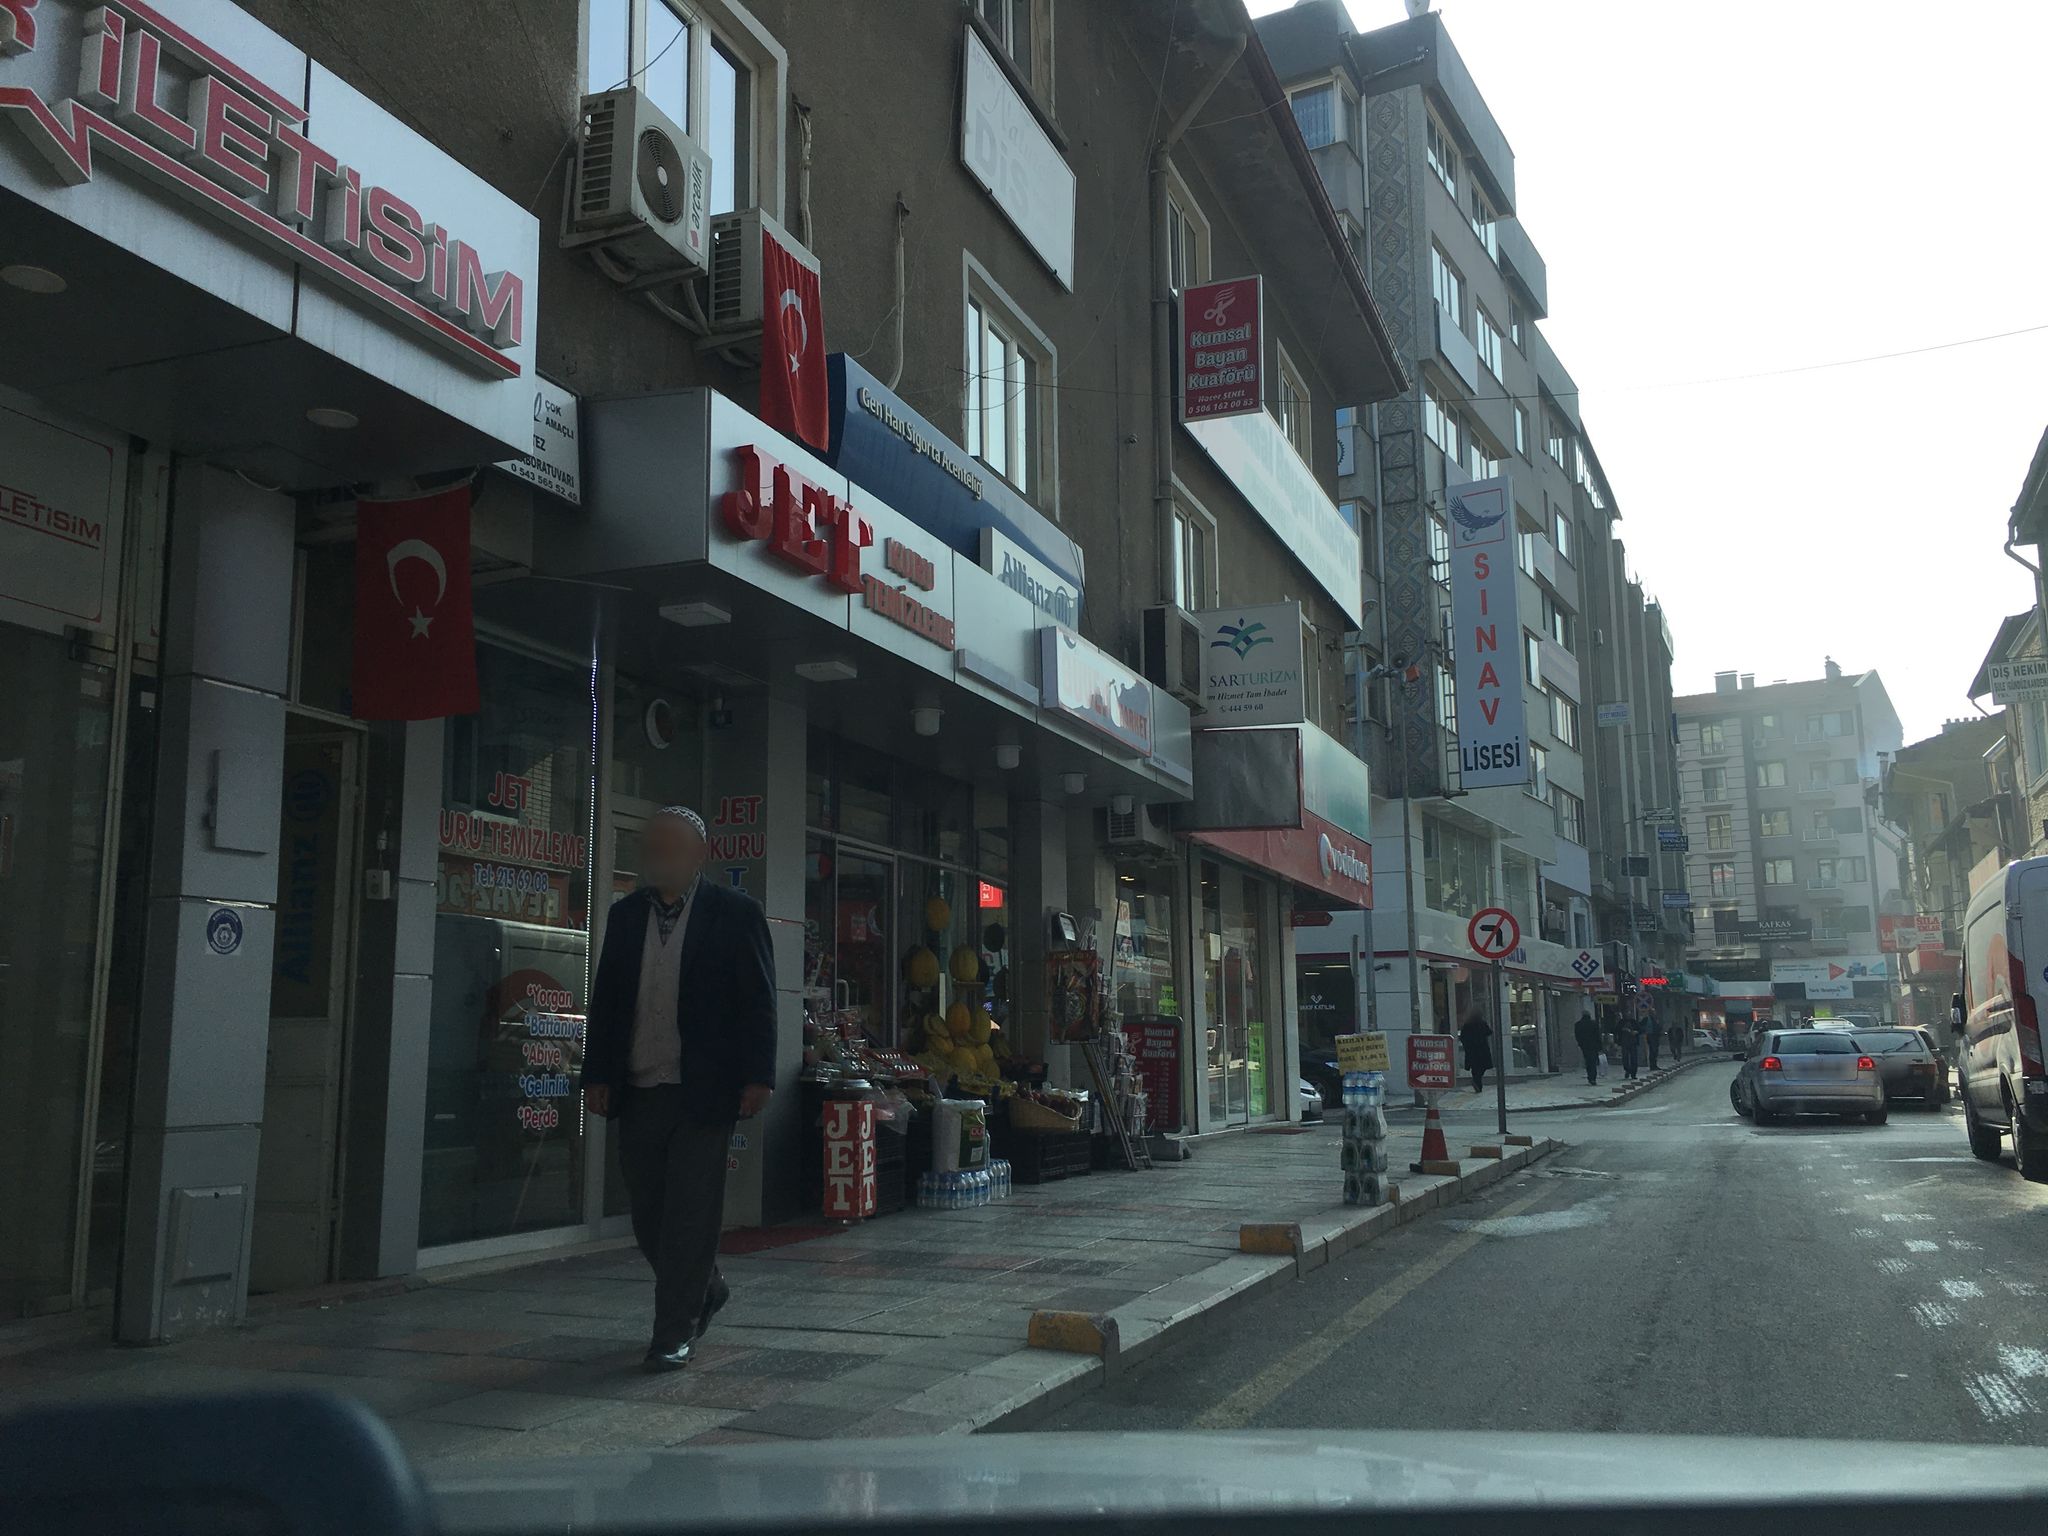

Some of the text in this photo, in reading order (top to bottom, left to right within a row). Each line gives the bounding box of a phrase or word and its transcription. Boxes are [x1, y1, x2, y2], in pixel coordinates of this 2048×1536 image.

[690, 160, 704, 230] arçelik
[1190, 323, 1252, 348] Kumsal
[1195, 347, 1248, 369] Bayan
[1187, 364, 1256, 390] Kuaförü
[545, 400, 562, 417] ÇOK
[545, 417, 575, 440] AMAÇLI
[860, 386, 885, 420] Gen
[883, 405, 907, 436] Han
[905, 423, 941, 465] Sigorta
[519, 468, 536, 481] 543
[520, 454, 575, 489] ABORATUVARI
[0, 491, 101, 543] LETİSİM
[718, 444, 873, 594] JET
[1001, 550, 1052, 609] Allianz
[1473, 552, 1501, 727] SINAV
[2013, 661, 2048, 677] HEKİM
[1246, 689, 1262, 698] Tam
[1462, 736, 1521, 772] LİSESİ
[489, 770, 532, 811] JET
[713, 795, 764, 827] JET
[438, 808, 587, 870] URU TEMİZLEME
[709, 832, 766, 861] KURU
[517, 869, 532, 892] 69
[533, 872, 549, 894] 08
[532, 984, 573, 1012] Yorgan
[531, 1014, 584, 1041] Battaniye
[528, 1042, 560, 1070] Abiye
[524, 1073, 570, 1098] Gelinlik
[522, 1103, 558, 1129] Perde
[826, 1103, 854, 1211] JET
[860, 1103, 874, 1211] JET
